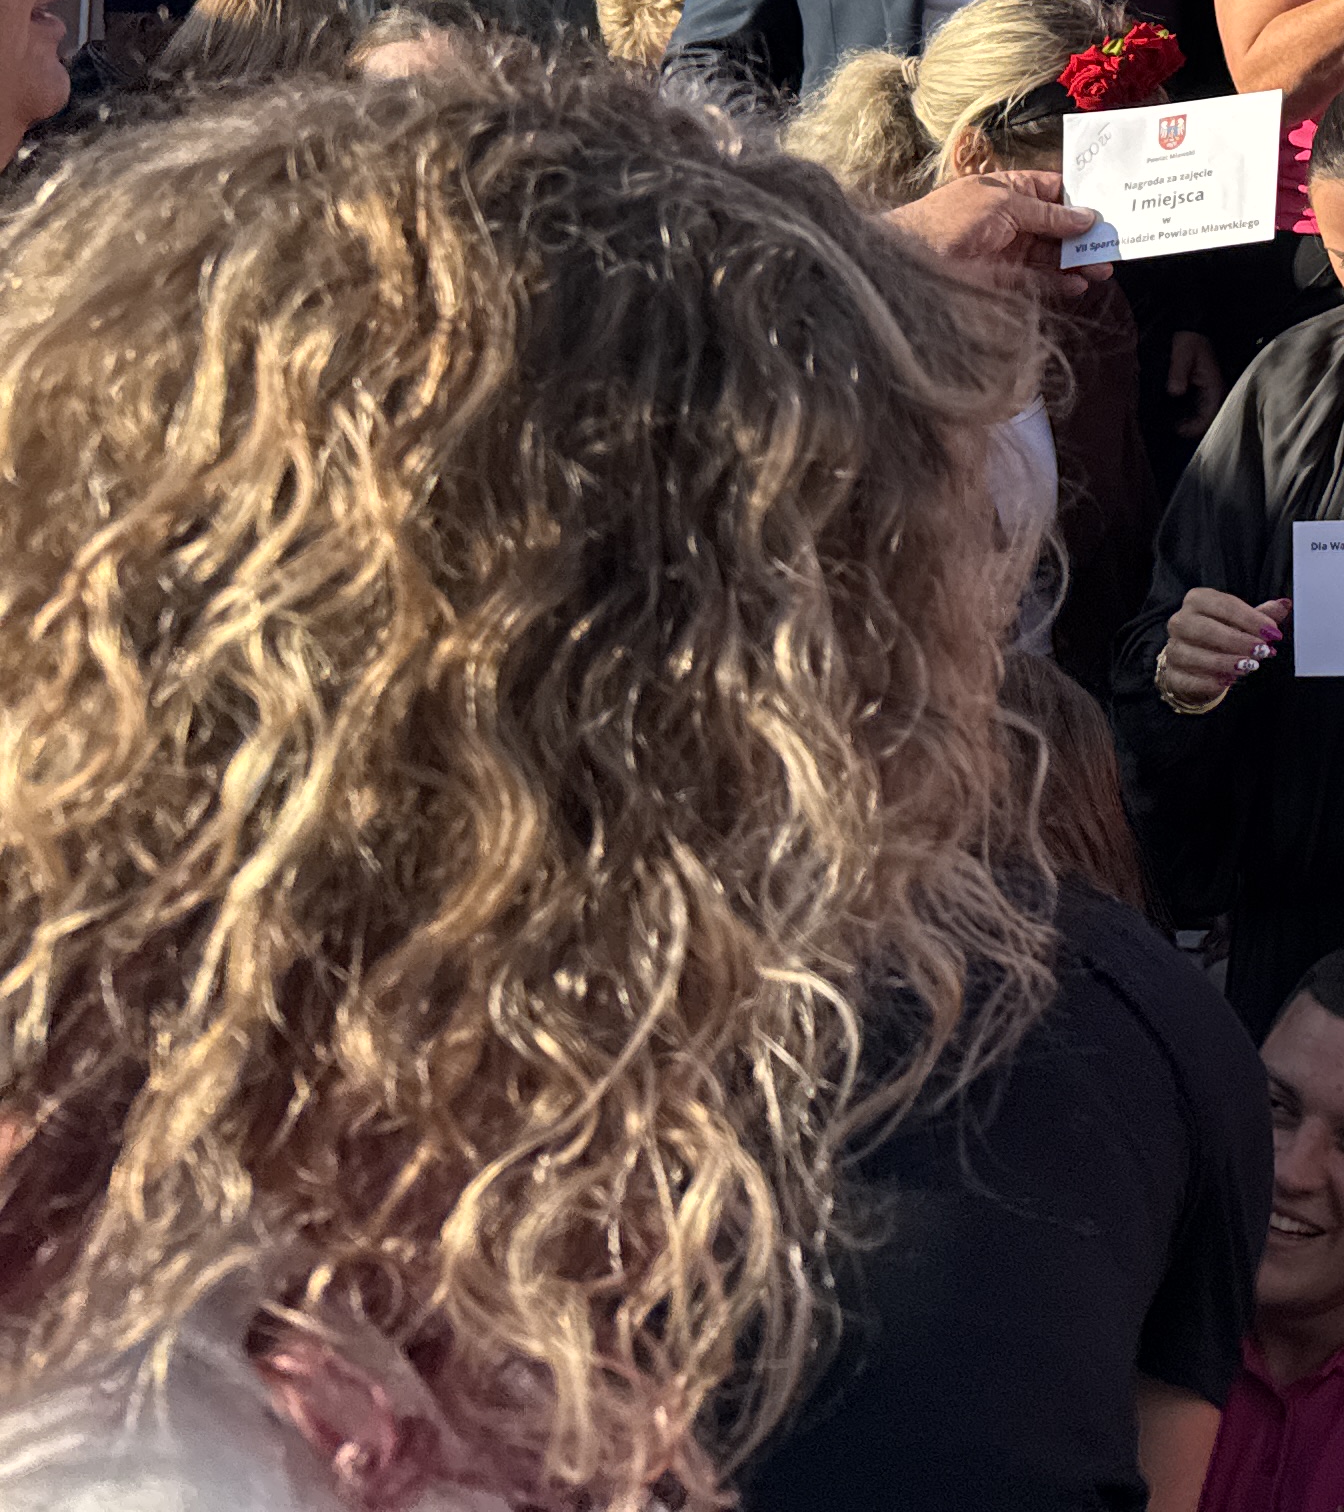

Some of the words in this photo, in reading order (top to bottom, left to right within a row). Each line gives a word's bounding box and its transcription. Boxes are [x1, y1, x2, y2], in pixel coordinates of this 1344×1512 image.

[1076, 142, 1099, 172] 500
[1124, 176, 1165, 191] Nagroda
[1166, 175, 1178, 183] za
[1179, 168, 1213, 181] zajęcie
[1132, 198, 1137, 212] I
[1141, 190, 1205, 210] miejsca
[1162, 217, 1171, 225] w
[1075, 243, 1088, 253] VII
[1089, 233, 1155, 252] Spartakiadzie
[1158, 228, 1198, 240] Powiatu
[1201, 219, 1260, 234] Mławskiego
[1310, 541, 1328, 551] Dla
